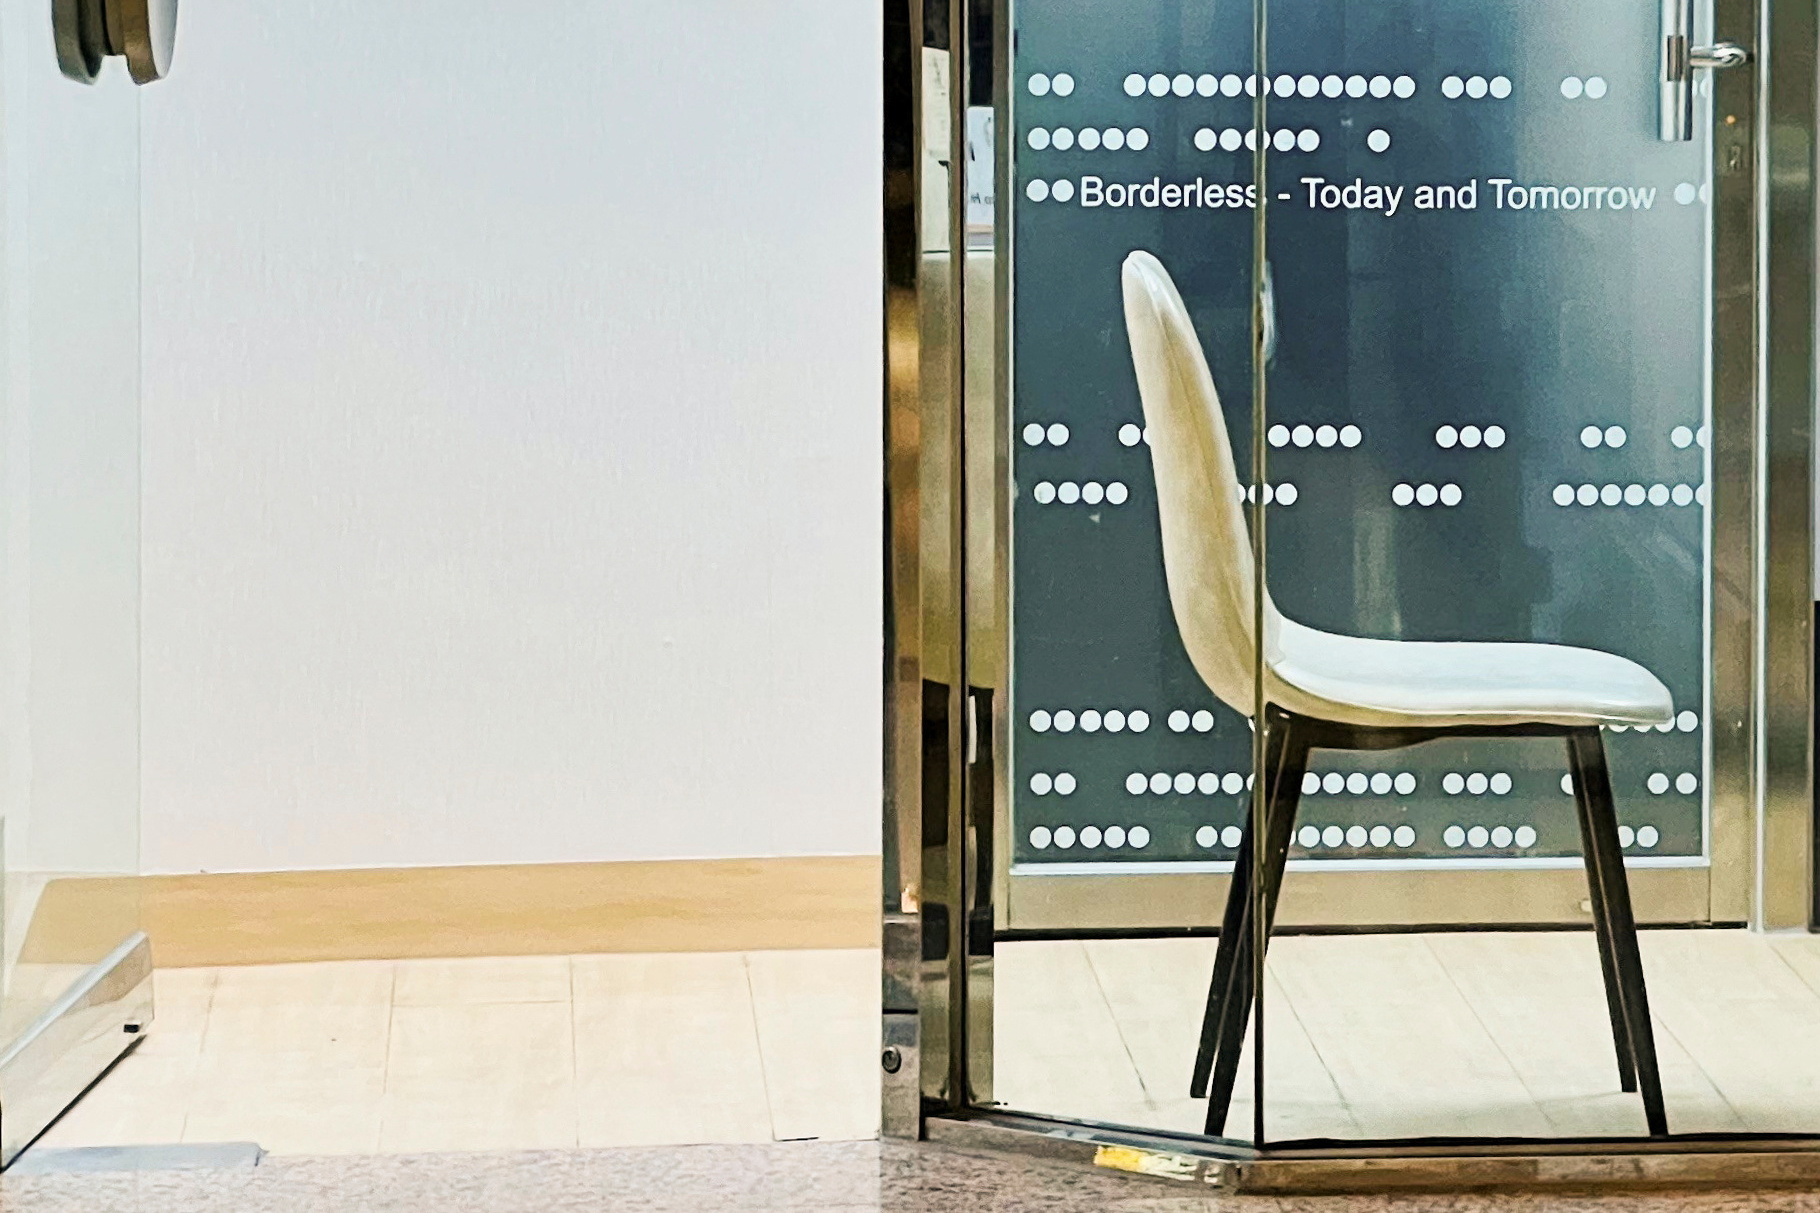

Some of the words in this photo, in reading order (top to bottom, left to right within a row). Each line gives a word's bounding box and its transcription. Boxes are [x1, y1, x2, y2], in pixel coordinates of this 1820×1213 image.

[1080, 175, 1268, 208] Borderless
[1301, 176, 1404, 217] Today
[1414, 178, 1477, 209] and
[1488, 178, 1657, 210] Tomorrow
